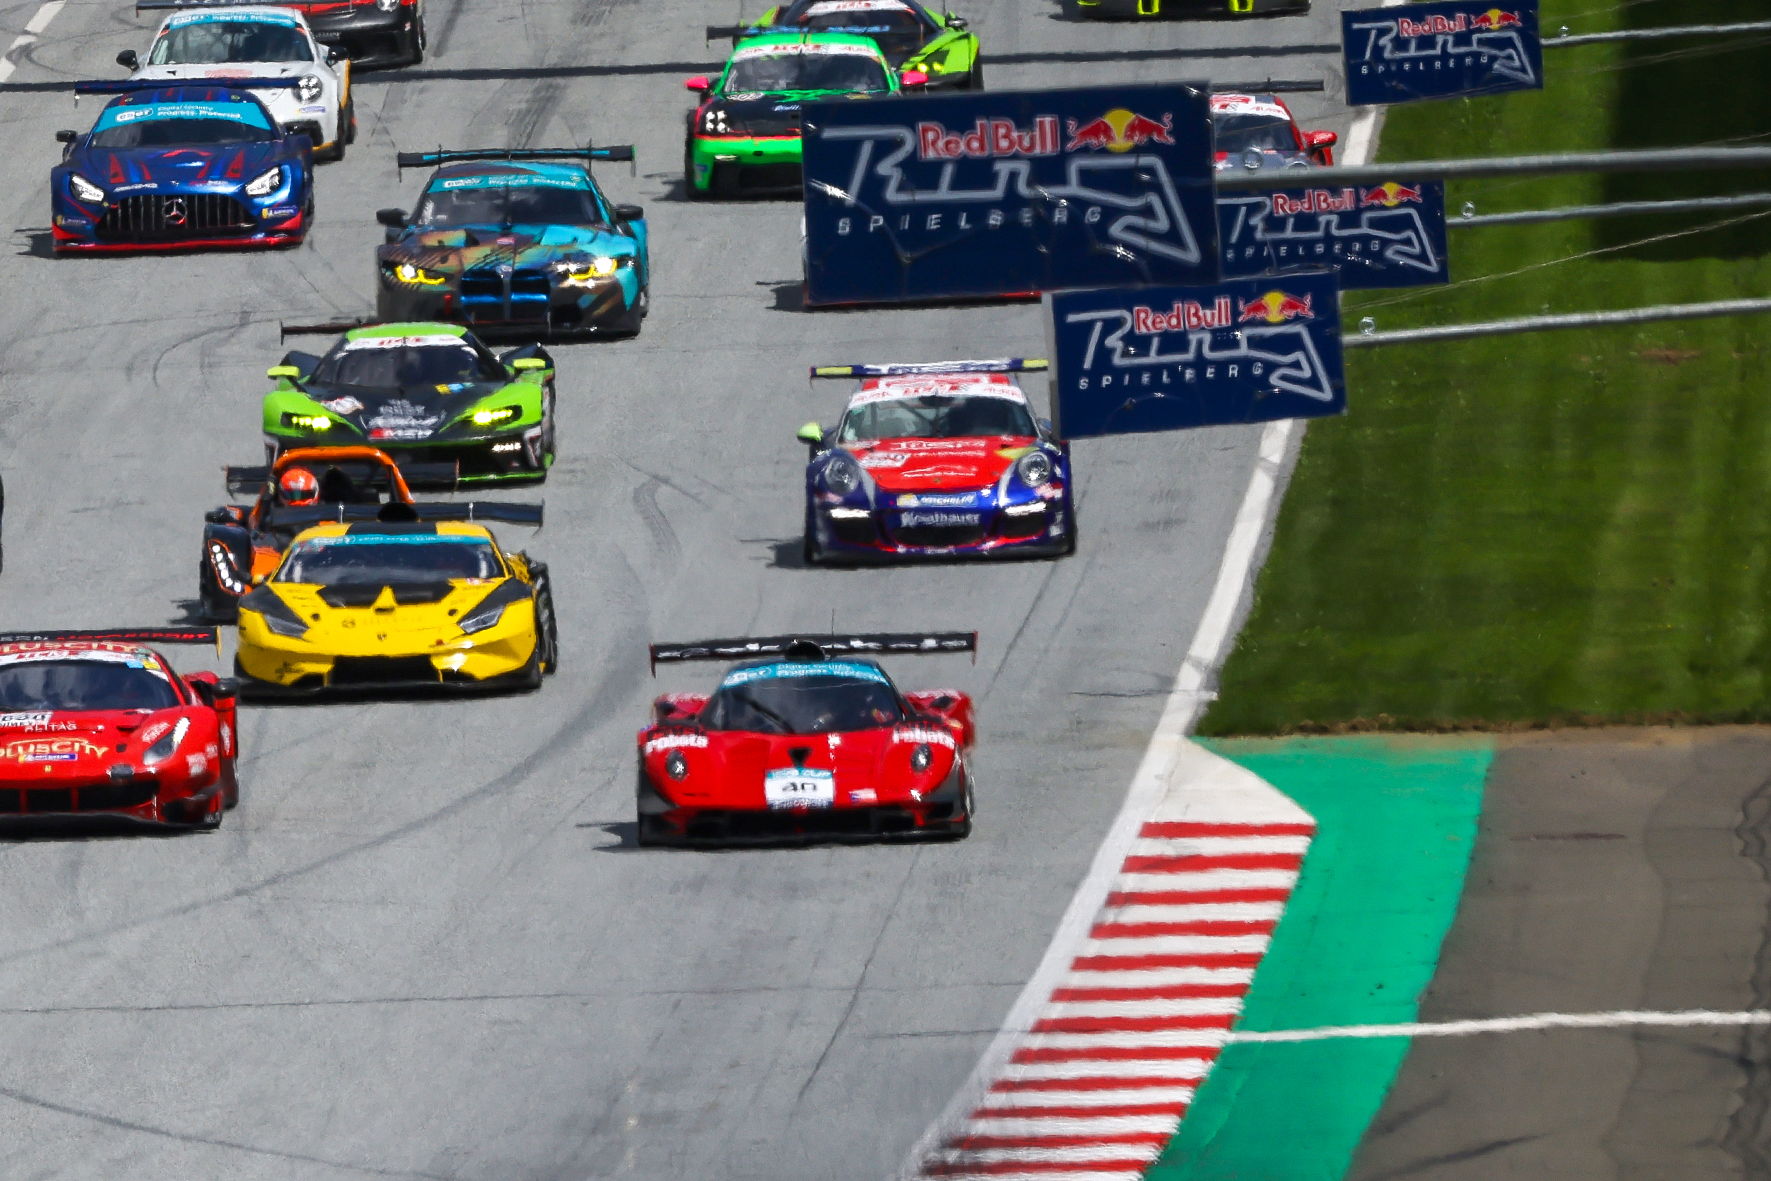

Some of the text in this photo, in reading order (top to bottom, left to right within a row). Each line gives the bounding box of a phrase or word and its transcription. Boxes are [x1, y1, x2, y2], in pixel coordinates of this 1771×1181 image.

[1397, 12, 1468, 37] Red Bull
[1361, 54, 1489, 75] SPIELBERG
[917, 114, 1061, 160] Red Bull
[1272, 188, 1356, 217] Red Bull
[837, 206, 1102, 236] SPIELBERG
[1226, 239, 1382, 261] SPIELBERG
[1133, 295, 1232, 335] Red Bull
[1078, 361, 1264, 391] SPIELBERG
[781, 781, 818, 792] 40
